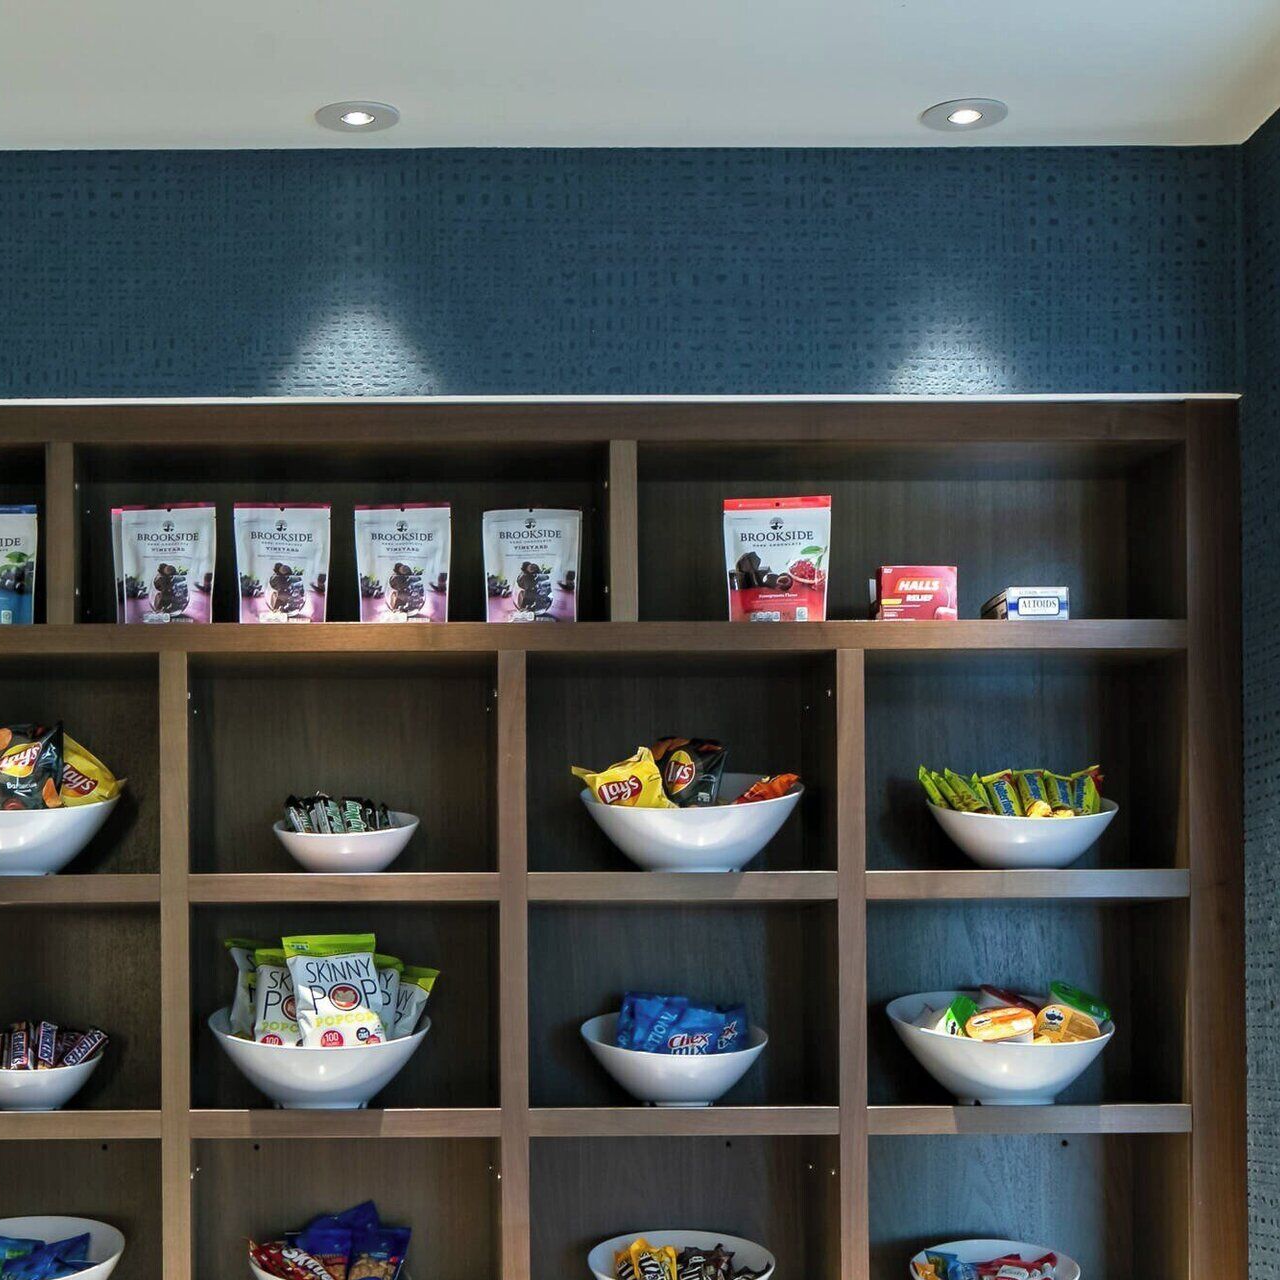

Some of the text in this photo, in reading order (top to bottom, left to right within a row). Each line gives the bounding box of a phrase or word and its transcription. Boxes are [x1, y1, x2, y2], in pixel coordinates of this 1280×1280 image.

[137, 532, 199, 543] BROOKSIDE
[251, 531, 313, 543] BROOKSIDE
[371, 532, 434, 543] BROOKSIDE
[499, 529, 562, 540] BROOKSIDE
[740, 530, 814, 542] BROOKSIDE
[898, 580, 941, 591] HALLS
[906, 594, 934, 602] RELIEF
[309, 978, 378, 1015] POP
[325, 1032, 339, 1043] 100
[668, 1032, 713, 1049] Chex
